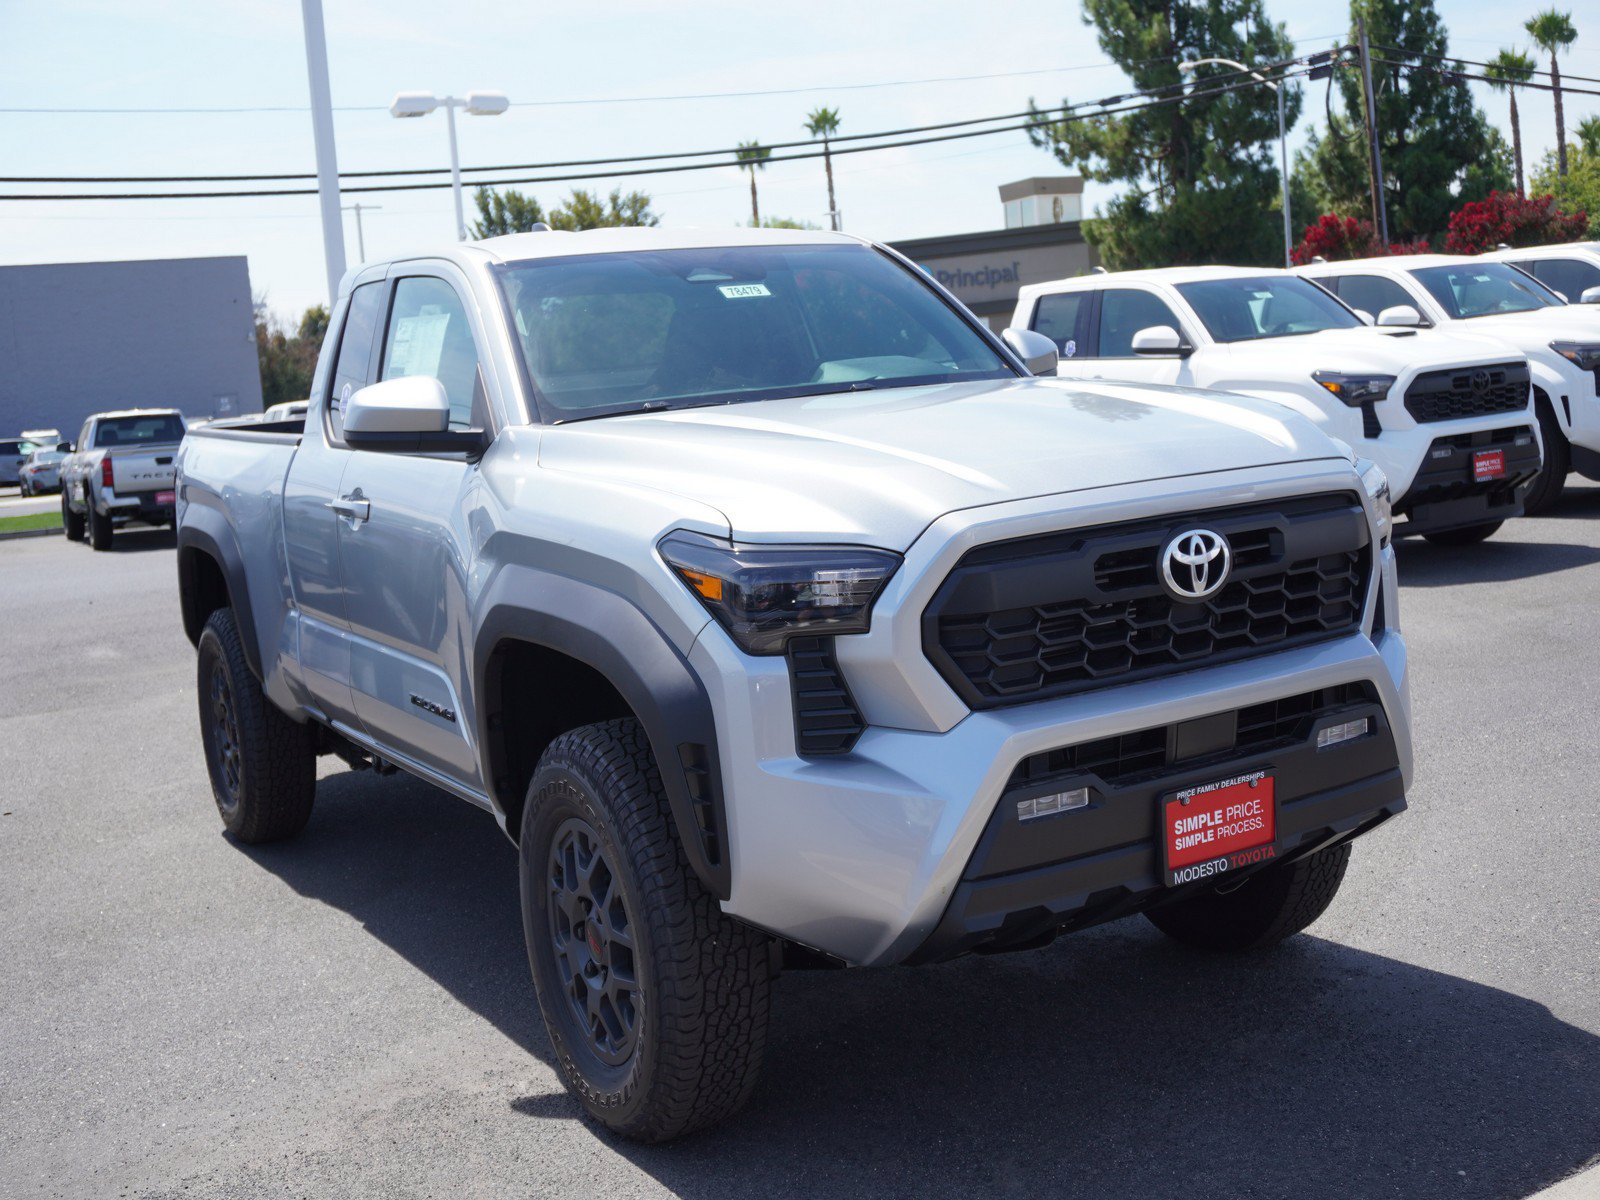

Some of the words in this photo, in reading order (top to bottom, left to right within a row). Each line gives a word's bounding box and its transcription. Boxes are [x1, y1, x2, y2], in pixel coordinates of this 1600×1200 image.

[936, 261, 1020, 289] Principal
[1177, 788, 1195, 800] PRICE
[1197, 781, 1220, 795] FAMILY
[1221, 771, 1265, 788] DEALERSHIPS
[1174, 809, 1223, 835] SIMPLE
[1226, 799, 1264, 821] PRICE.
[1175, 829, 1215, 851] SIMPLE
[1217, 816, 1265, 839] PROCESS.
[1174, 858, 1228, 885] MODESTO
[1230, 846, 1276, 869] TOYOTA
